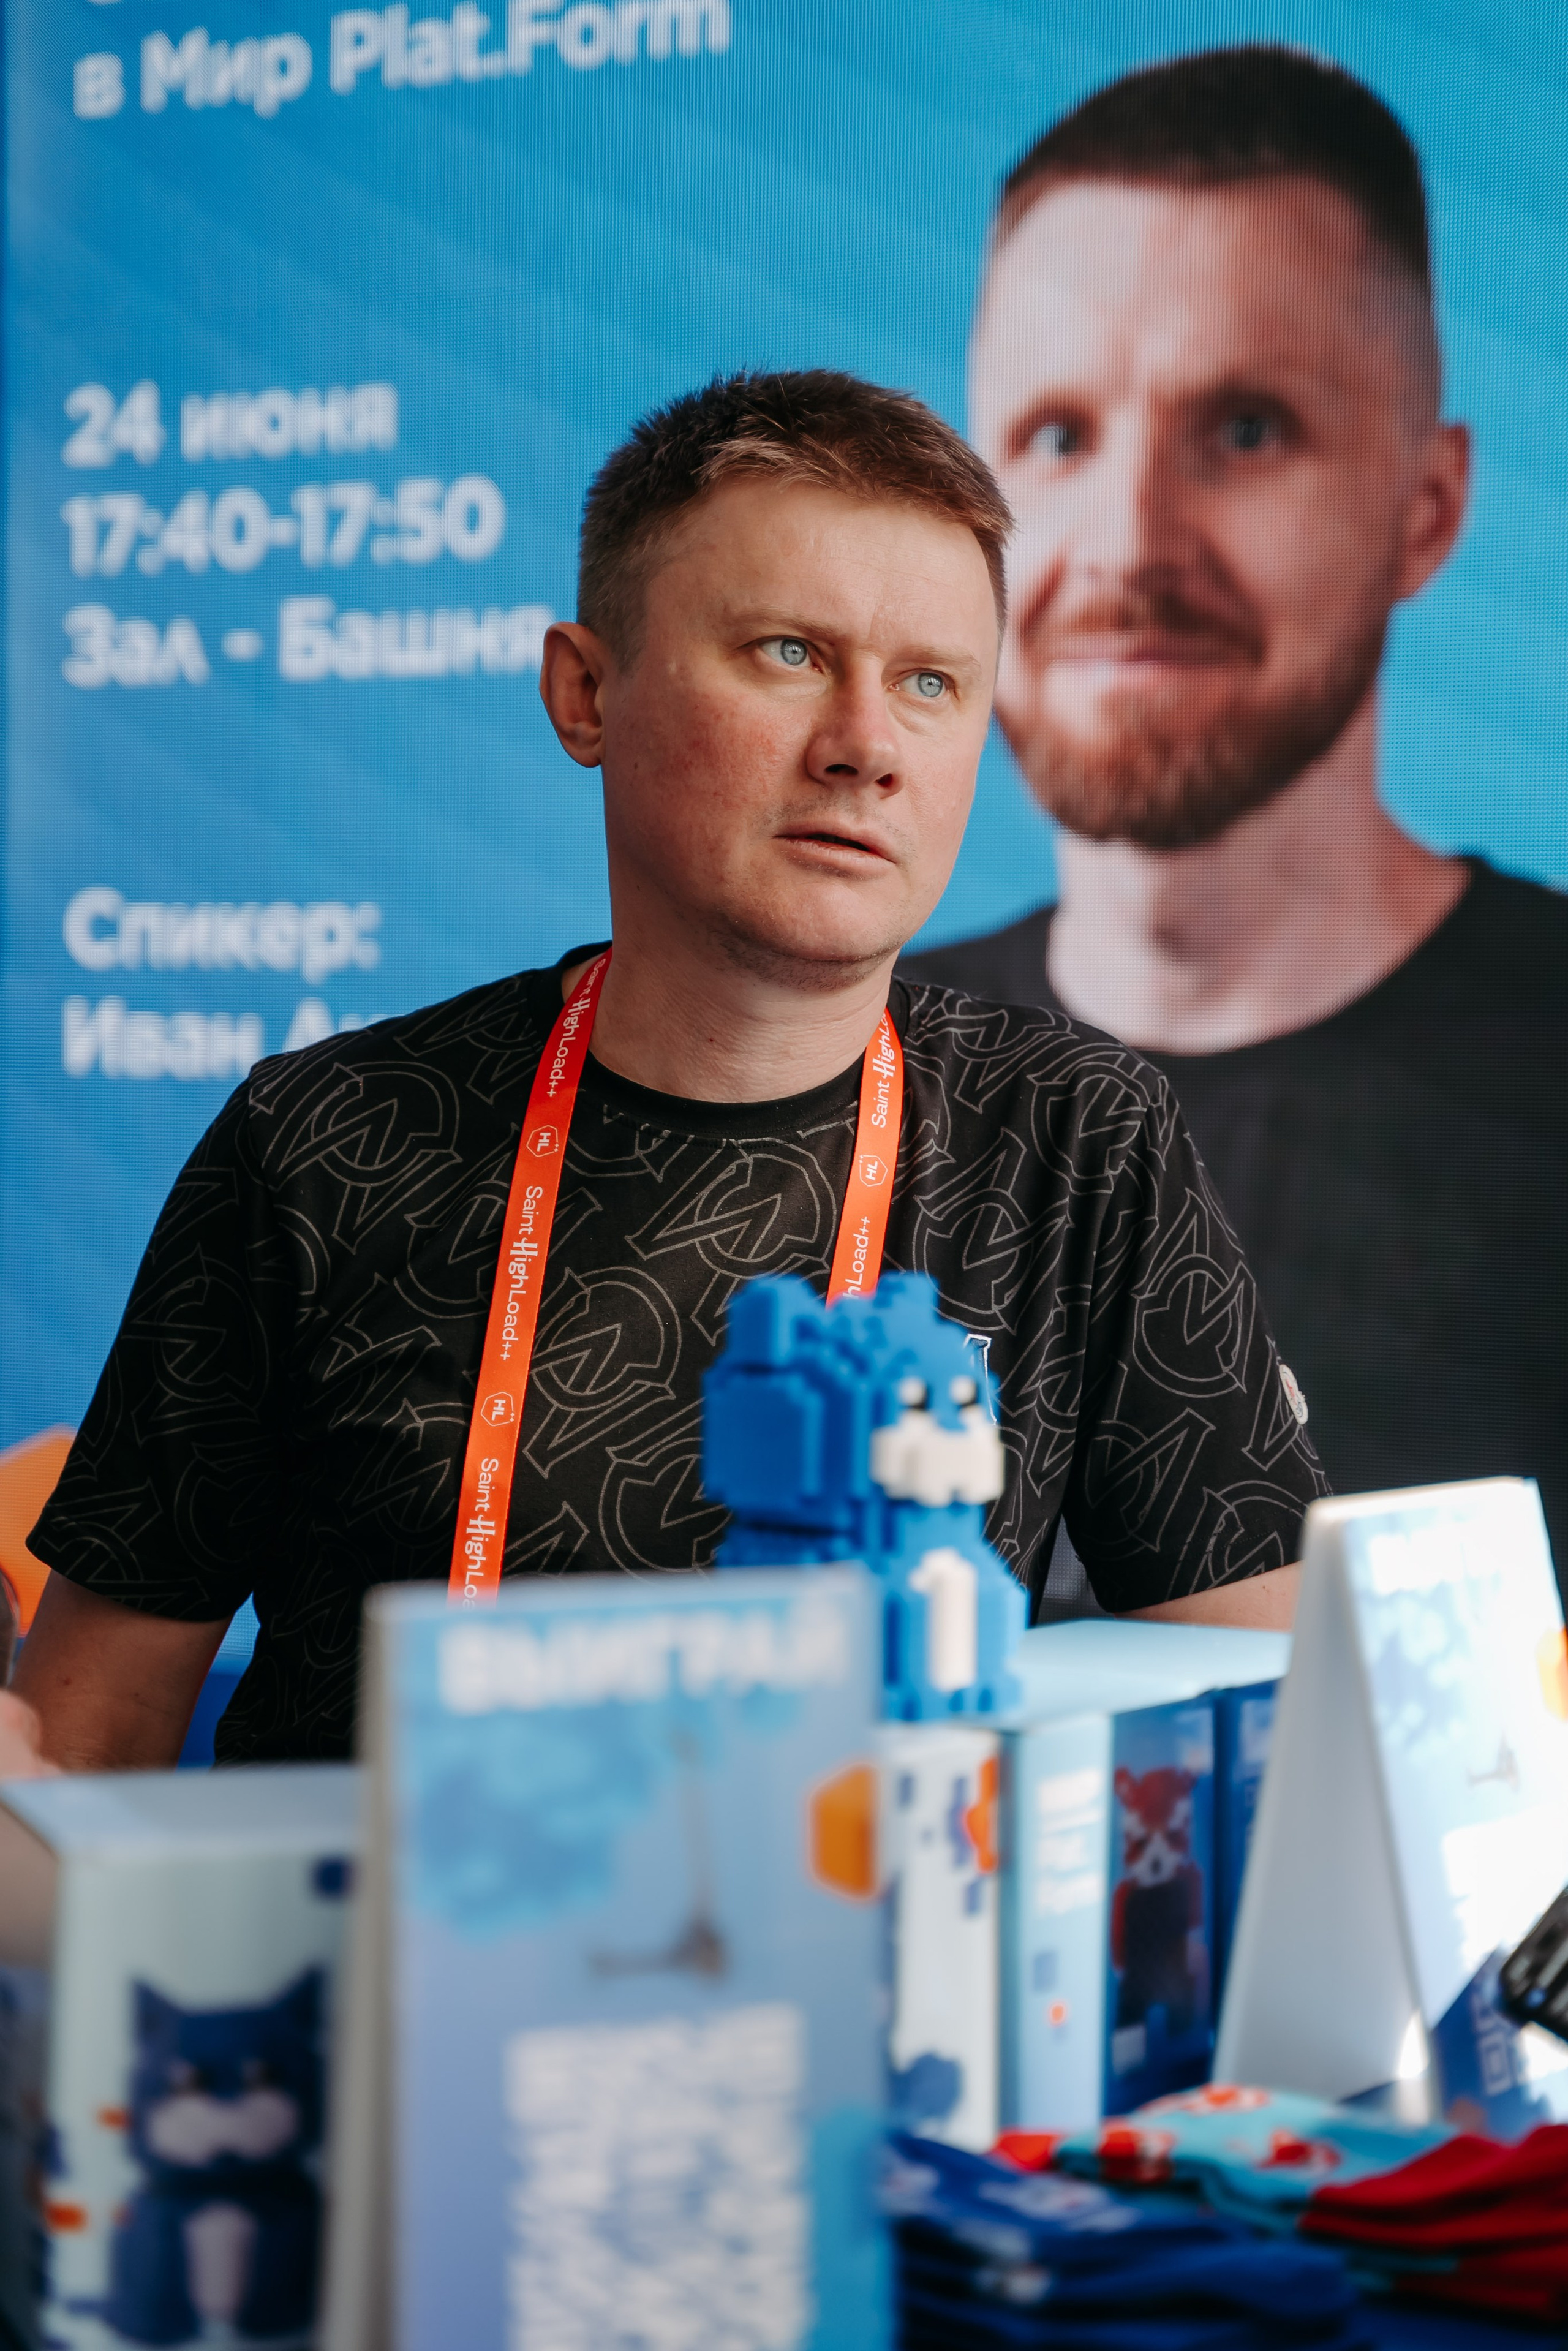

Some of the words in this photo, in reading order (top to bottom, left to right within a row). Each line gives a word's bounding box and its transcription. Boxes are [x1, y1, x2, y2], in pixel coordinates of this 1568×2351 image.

[74, 51, 125, 119] в
[140, 26, 312, 119] Мир
[331, 0, 733, 94] Plat.Form
[62, 379, 166, 469] 24
[180, 382, 399, 462] июня
[61, 473, 507, 578] 17:40-17:50
[62, 603, 210, 688] Зал
[222, 628, 263, 661] -
[280, 595, 554, 681] Башня
[64, 886, 382, 986] Спикер:
[581, 957, 606, 995] Saint
[63, 994, 263, 1081] Иван
[546, 994, 590, 1097] HighLoad++
[872, 1013, 895, 1079] HighLo
[872, 1080, 890, 1128] Saint
[518, 1185, 543, 1236] Saint
[500, 1236, 538, 1361] HighLoad++
[843, 1216, 870, 1299] hLoad++
[475, 1457, 499, 1512] Saint
[462, 1514, 496, 1610] HighLoa
